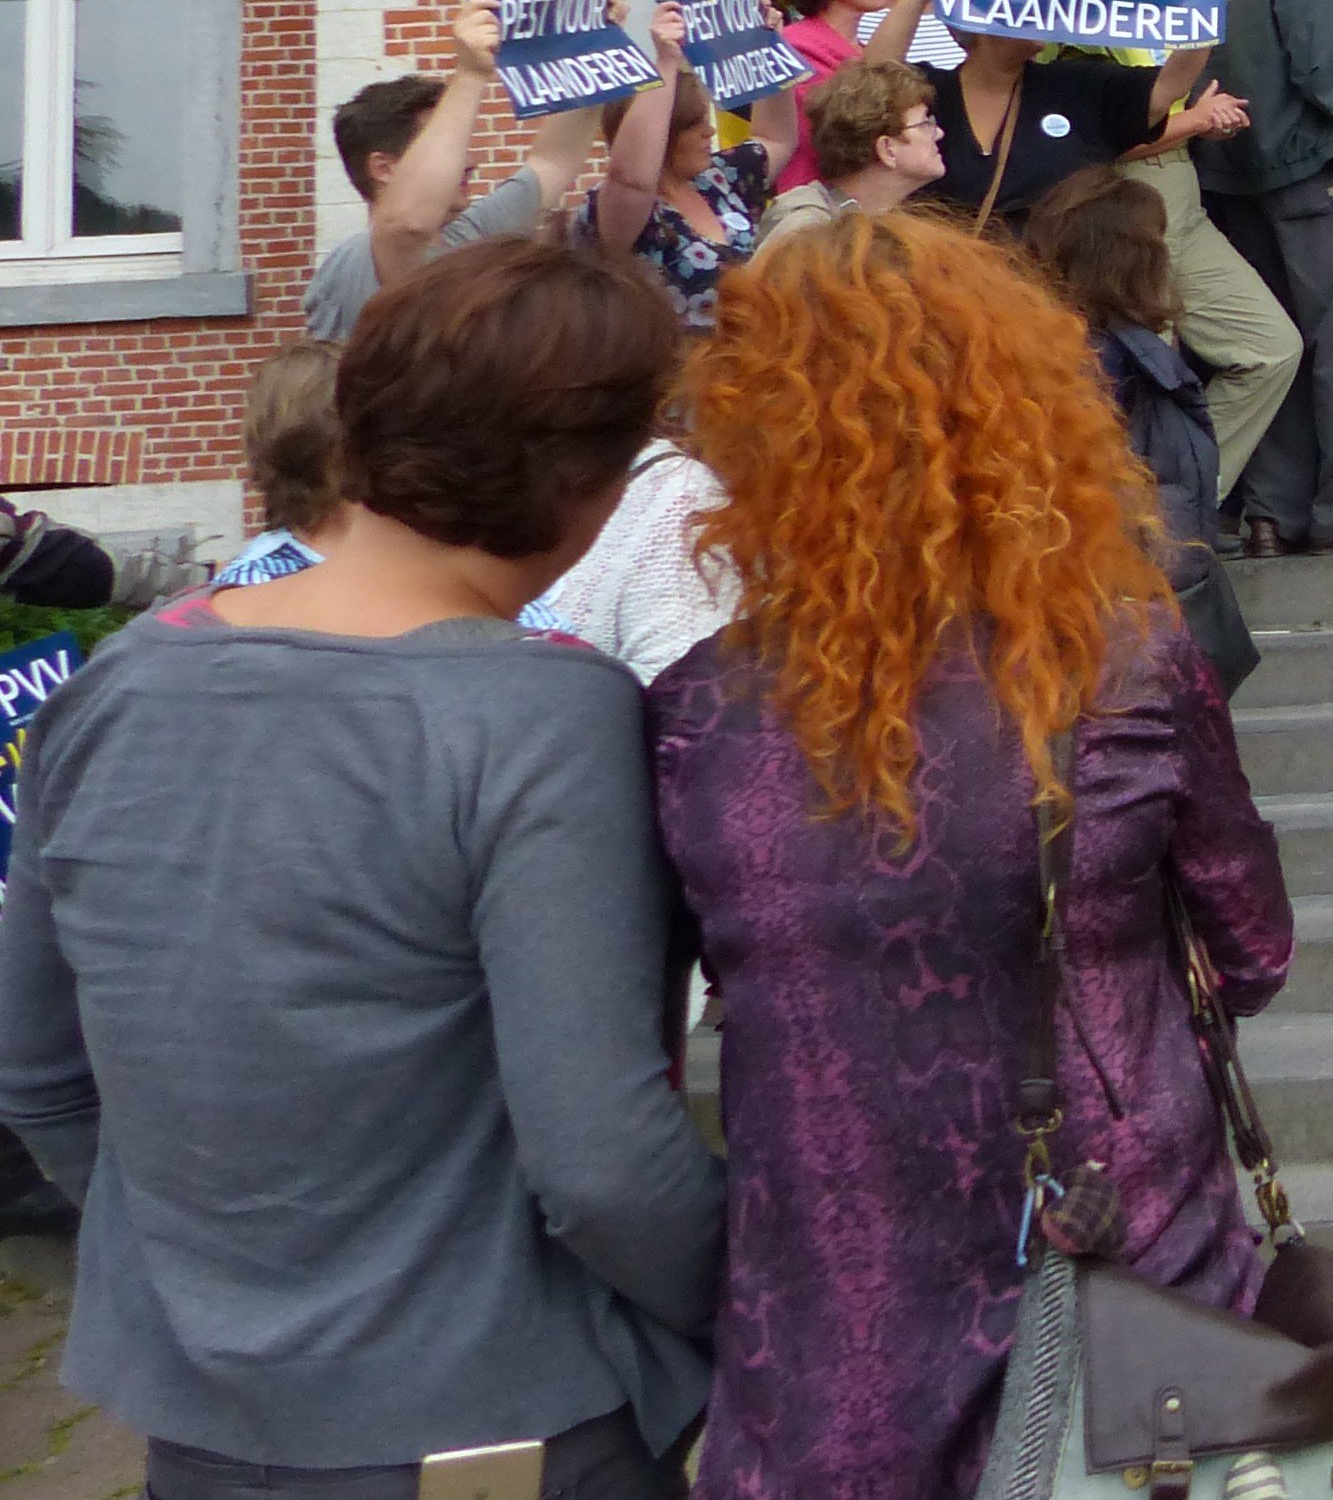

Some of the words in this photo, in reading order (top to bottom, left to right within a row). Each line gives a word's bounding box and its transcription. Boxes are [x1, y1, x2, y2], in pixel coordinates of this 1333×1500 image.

[682, 0, 721, 43] PEST
[496, 45, 656, 107] VLAANDEREN
[0, 649, 71, 717] PVV
